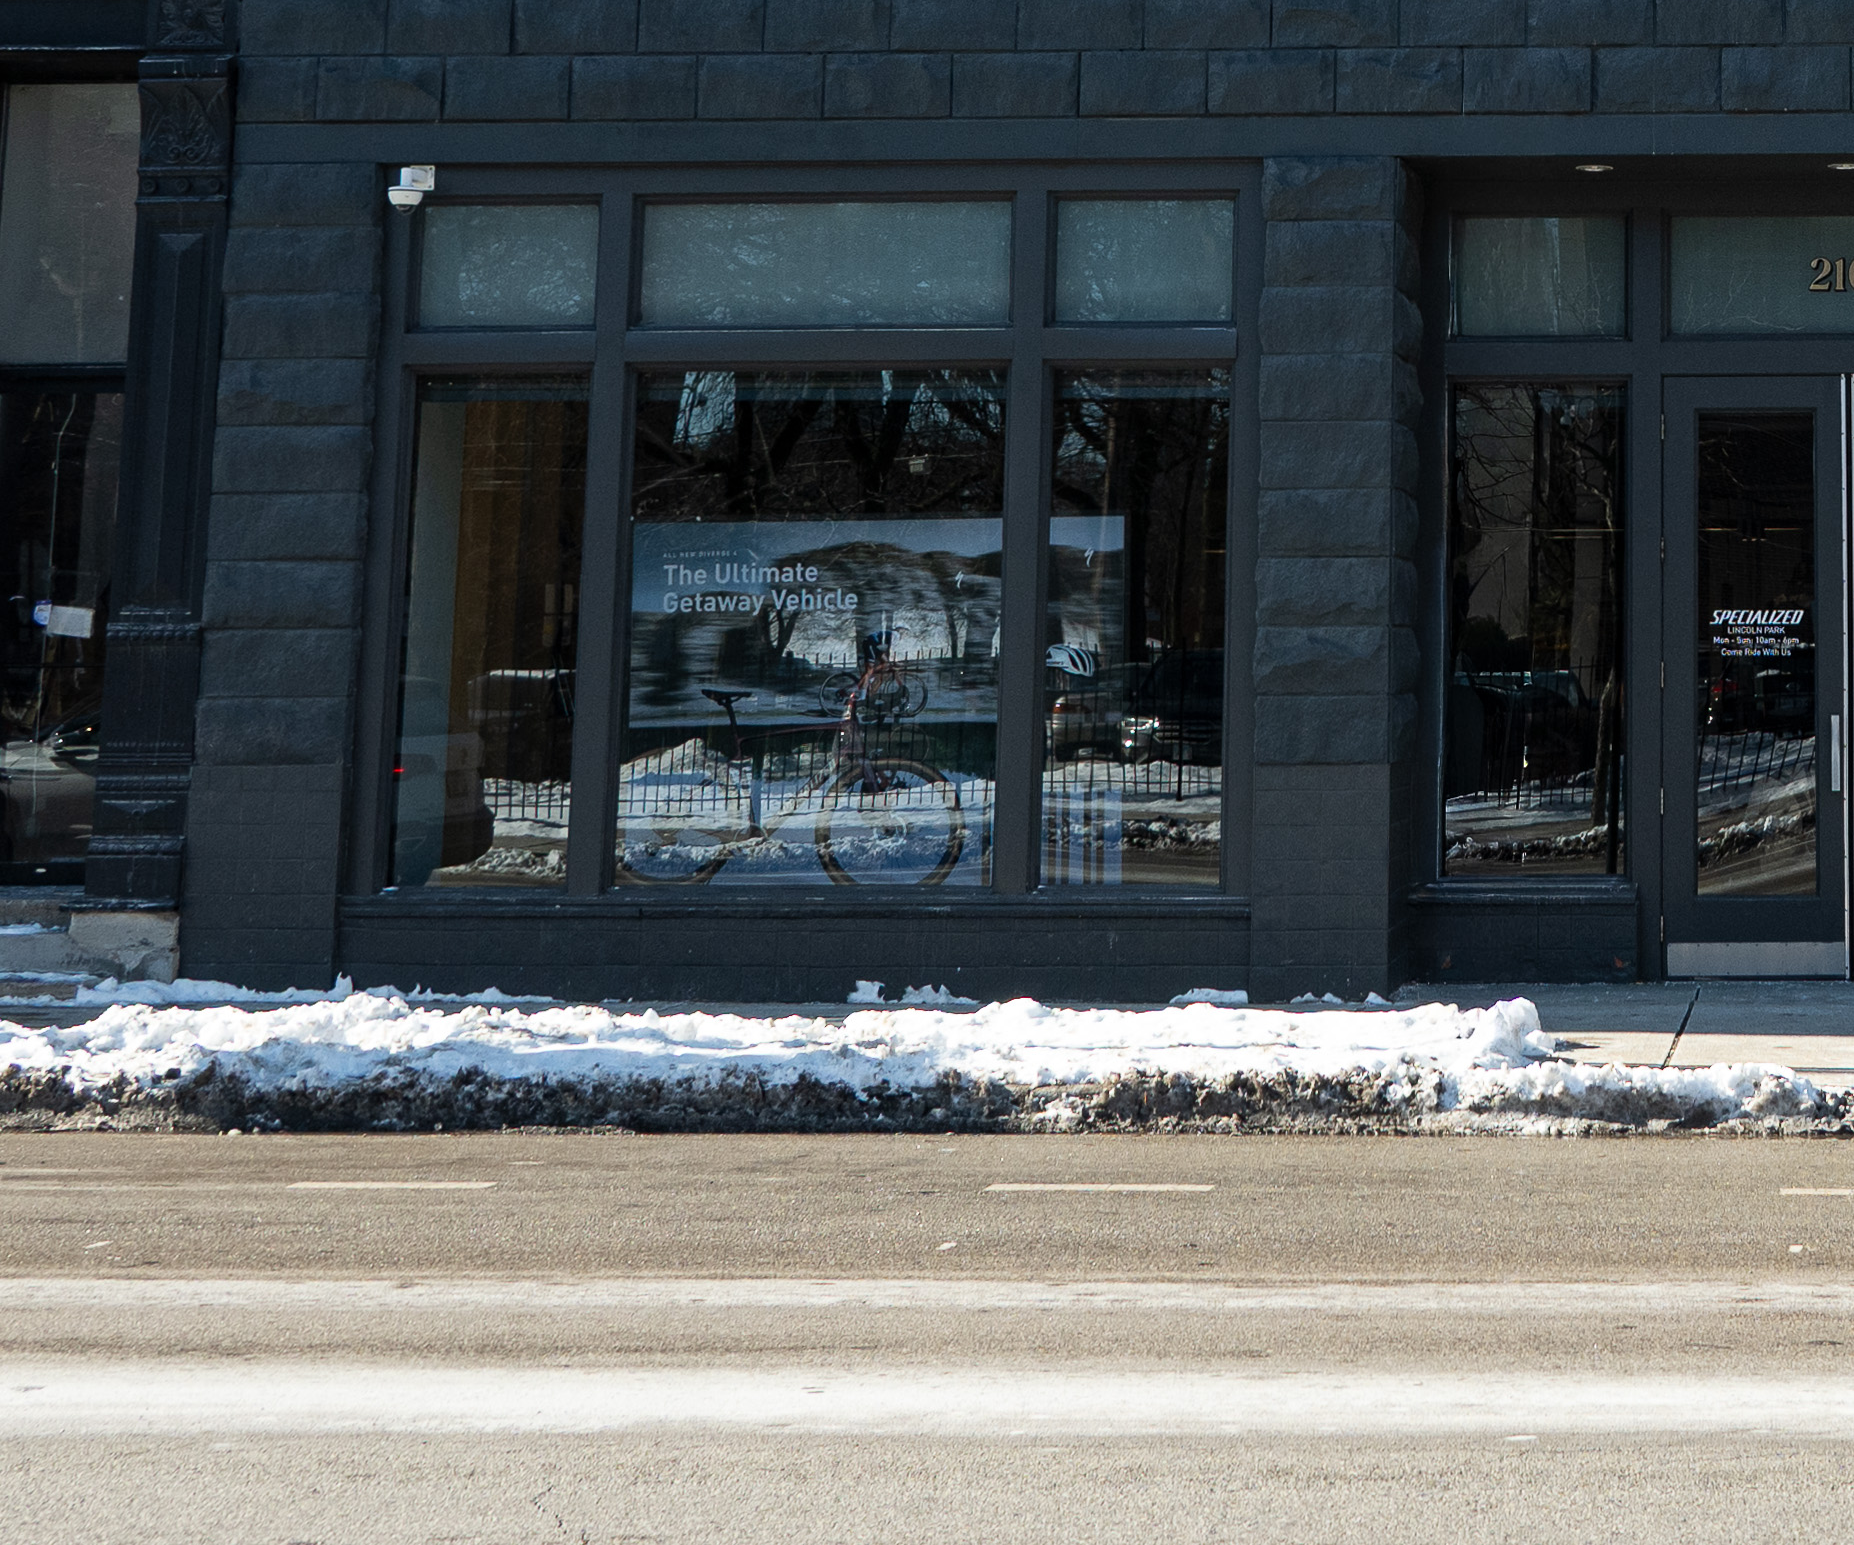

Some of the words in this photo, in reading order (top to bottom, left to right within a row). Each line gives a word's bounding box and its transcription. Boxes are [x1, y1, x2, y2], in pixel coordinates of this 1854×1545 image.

[663, 563, 707, 586] The
[714, 562, 819, 585] Ultimate
[663, 592, 765, 616] Getaway
[771, 588, 859, 612] Vehicle
[1709, 609, 1805, 625] SPECIALIZED
[1727, 626, 1762, 635] LINCOLN
[1764, 626, 1786, 635] PARK
[1713, 636, 1730, 644] Mon
[1755, 636, 1776, 644] 10am
[1782, 636, 1800, 646] 6pm
[1721, 648, 1743, 656] Come
[1744, 647, 1761, 656] Ride
[1762, 647, 1780, 656] With
[1781, 647, 1792, 656] Us
